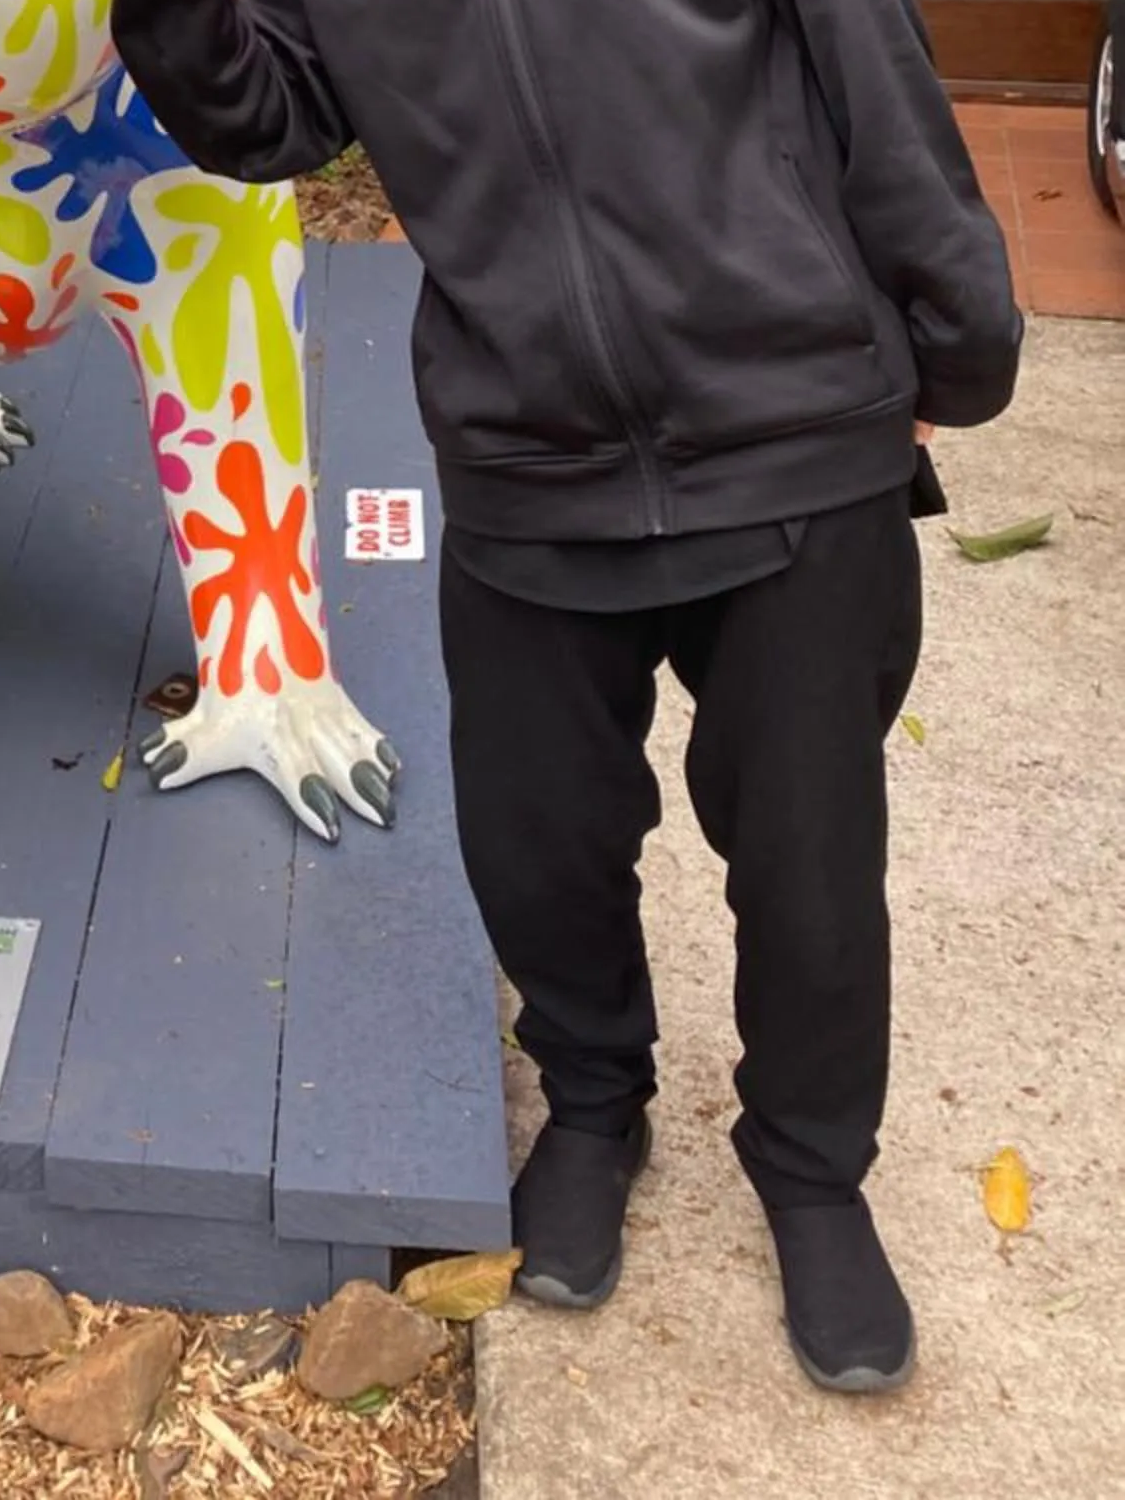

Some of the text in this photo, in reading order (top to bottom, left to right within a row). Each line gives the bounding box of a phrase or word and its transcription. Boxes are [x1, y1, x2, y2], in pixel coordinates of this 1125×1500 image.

[357, 494, 380, 553] DO NOT
[387, 499, 411, 546] CLIMB
